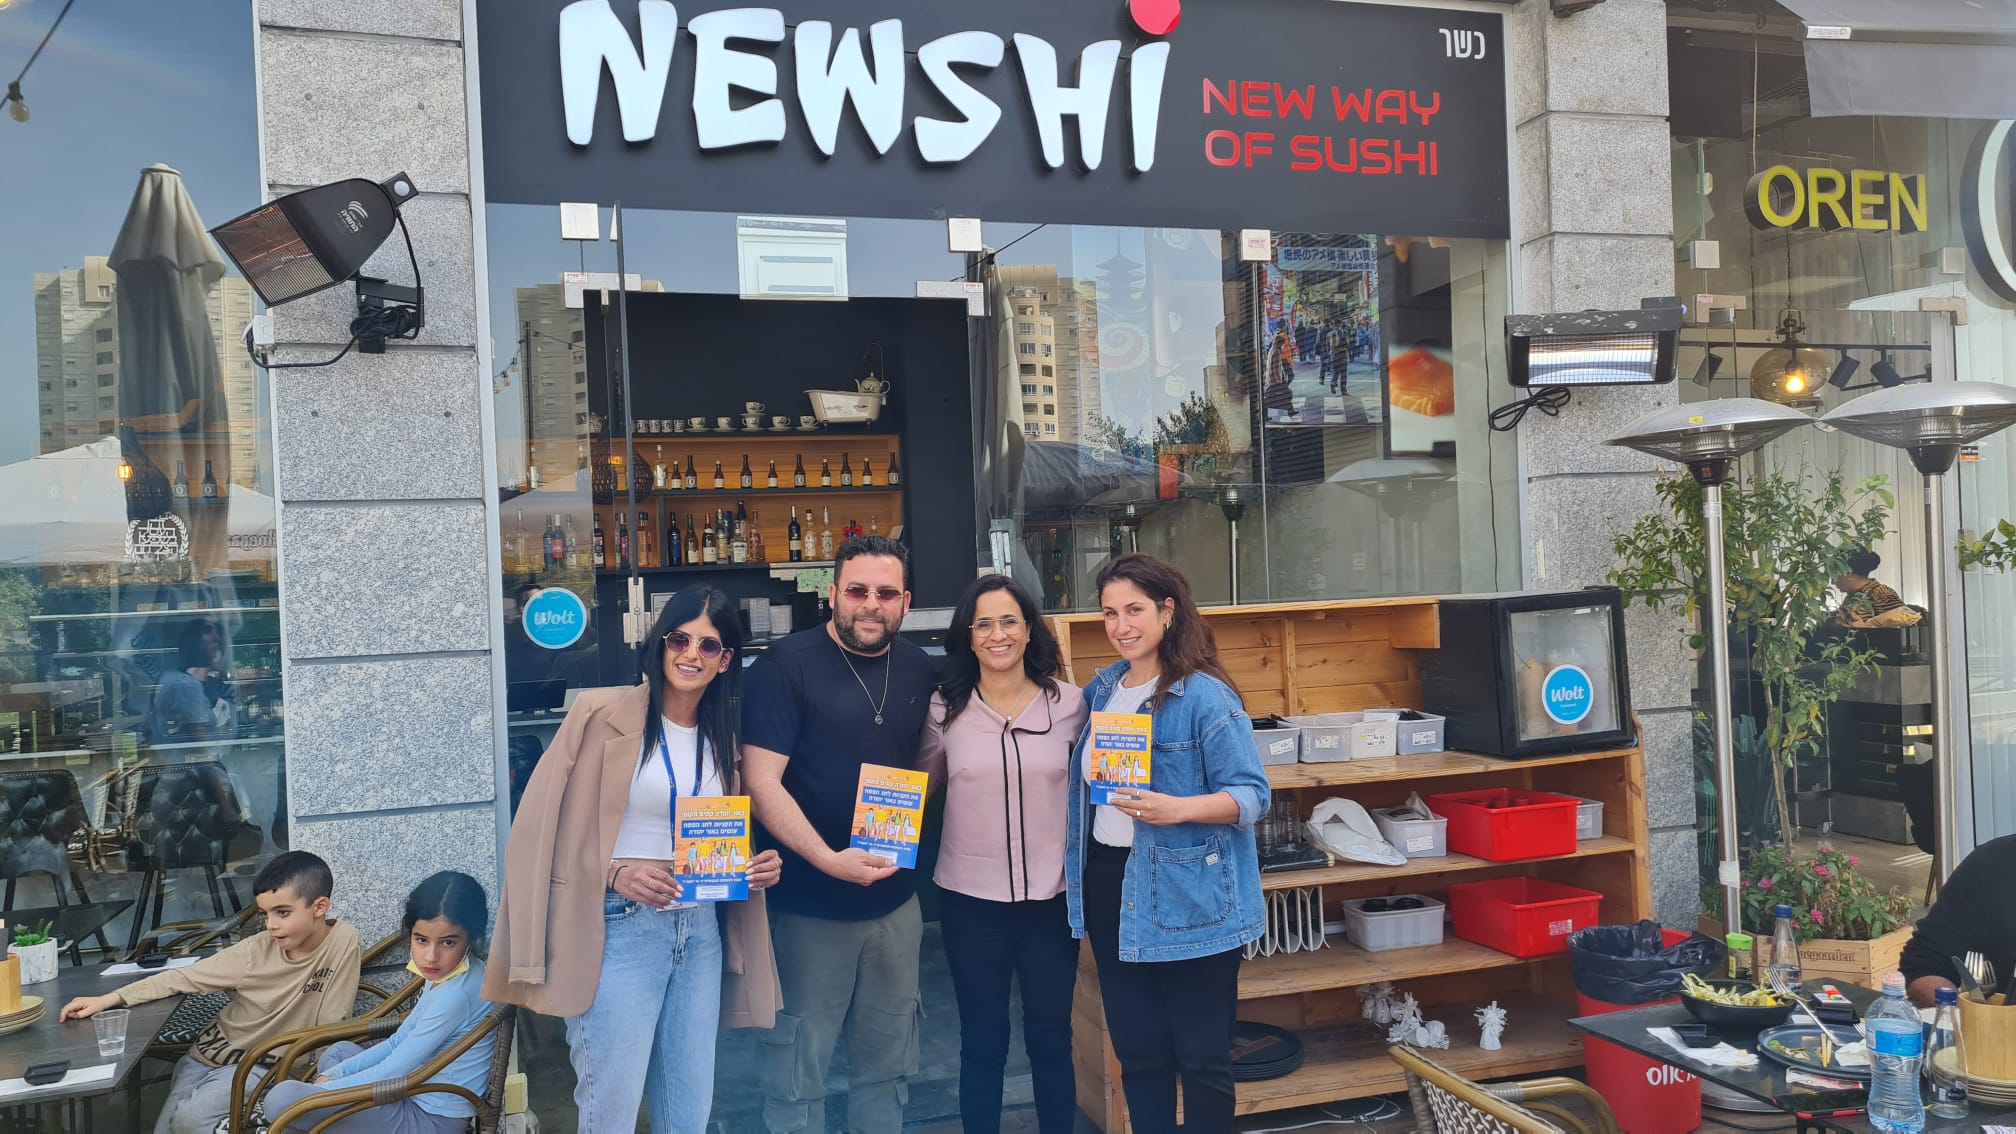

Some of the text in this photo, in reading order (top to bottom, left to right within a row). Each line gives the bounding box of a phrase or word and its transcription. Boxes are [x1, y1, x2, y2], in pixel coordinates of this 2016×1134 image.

[1439, 28, 1486, 60] כשר
[1203, 78, 1441, 126] NEW WAY
[1205, 129, 1438, 175] OF SUSHI
[1758, 165, 1928, 232] OREN
[534, 609, 577, 625] Wolt
[1551, 685, 1585, 702] Wolt
[1800, 949, 1855, 962] oegaarden
